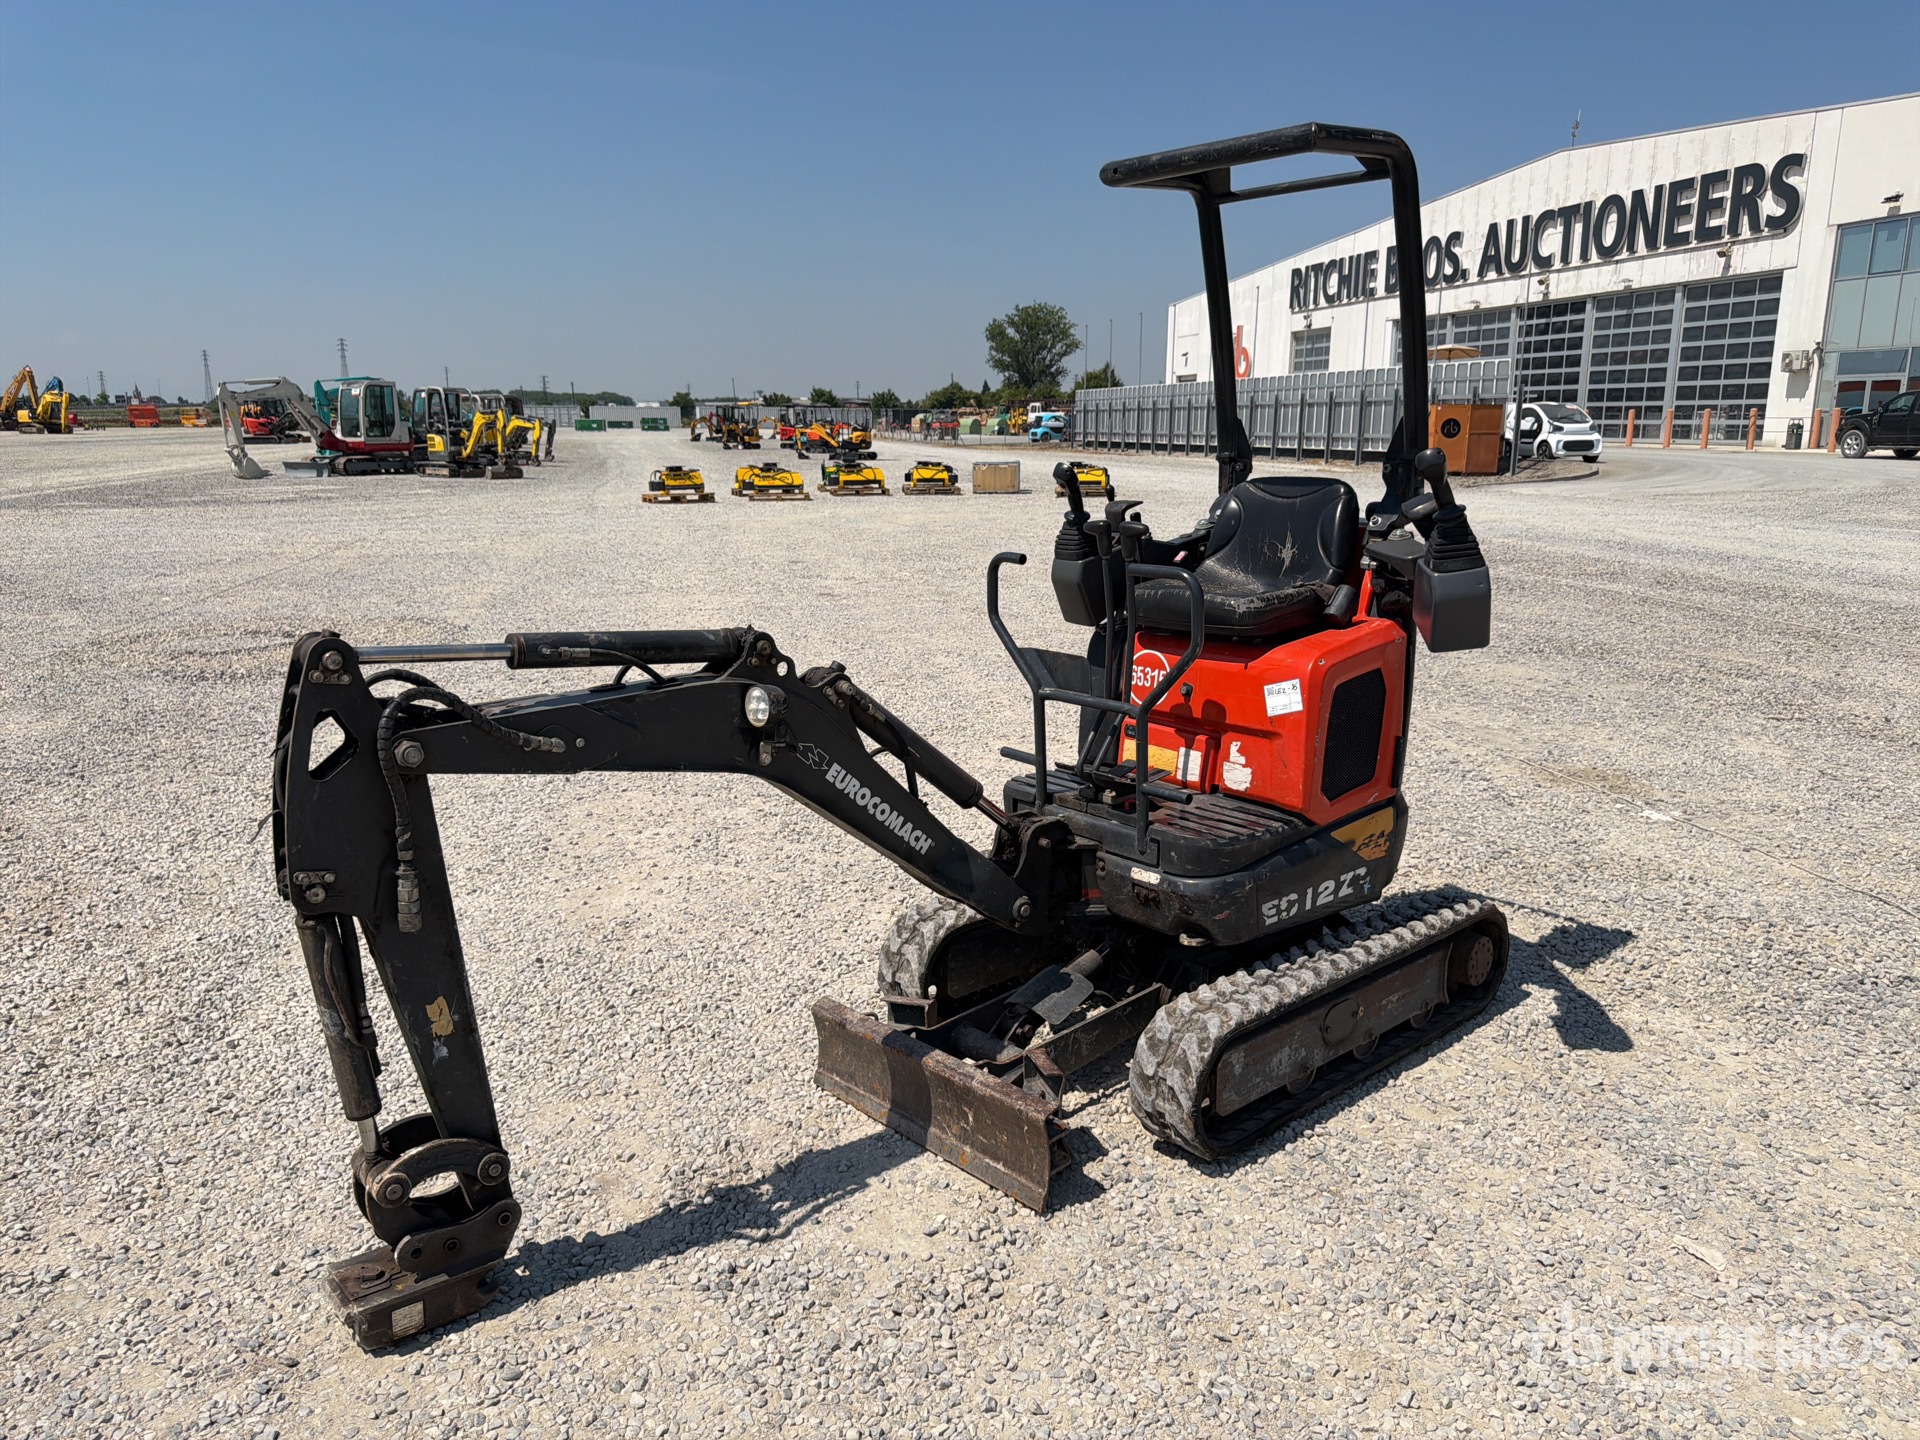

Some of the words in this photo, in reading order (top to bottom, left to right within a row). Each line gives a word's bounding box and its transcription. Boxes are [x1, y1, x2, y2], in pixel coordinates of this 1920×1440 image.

[1290, 250, 1378, 309] RITCHIE
[1385, 231, 1469, 297] BOS.
[1477, 153, 1806, 278] AUCTIONEERS
[825, 762, 932, 855] EUROCOMACH
